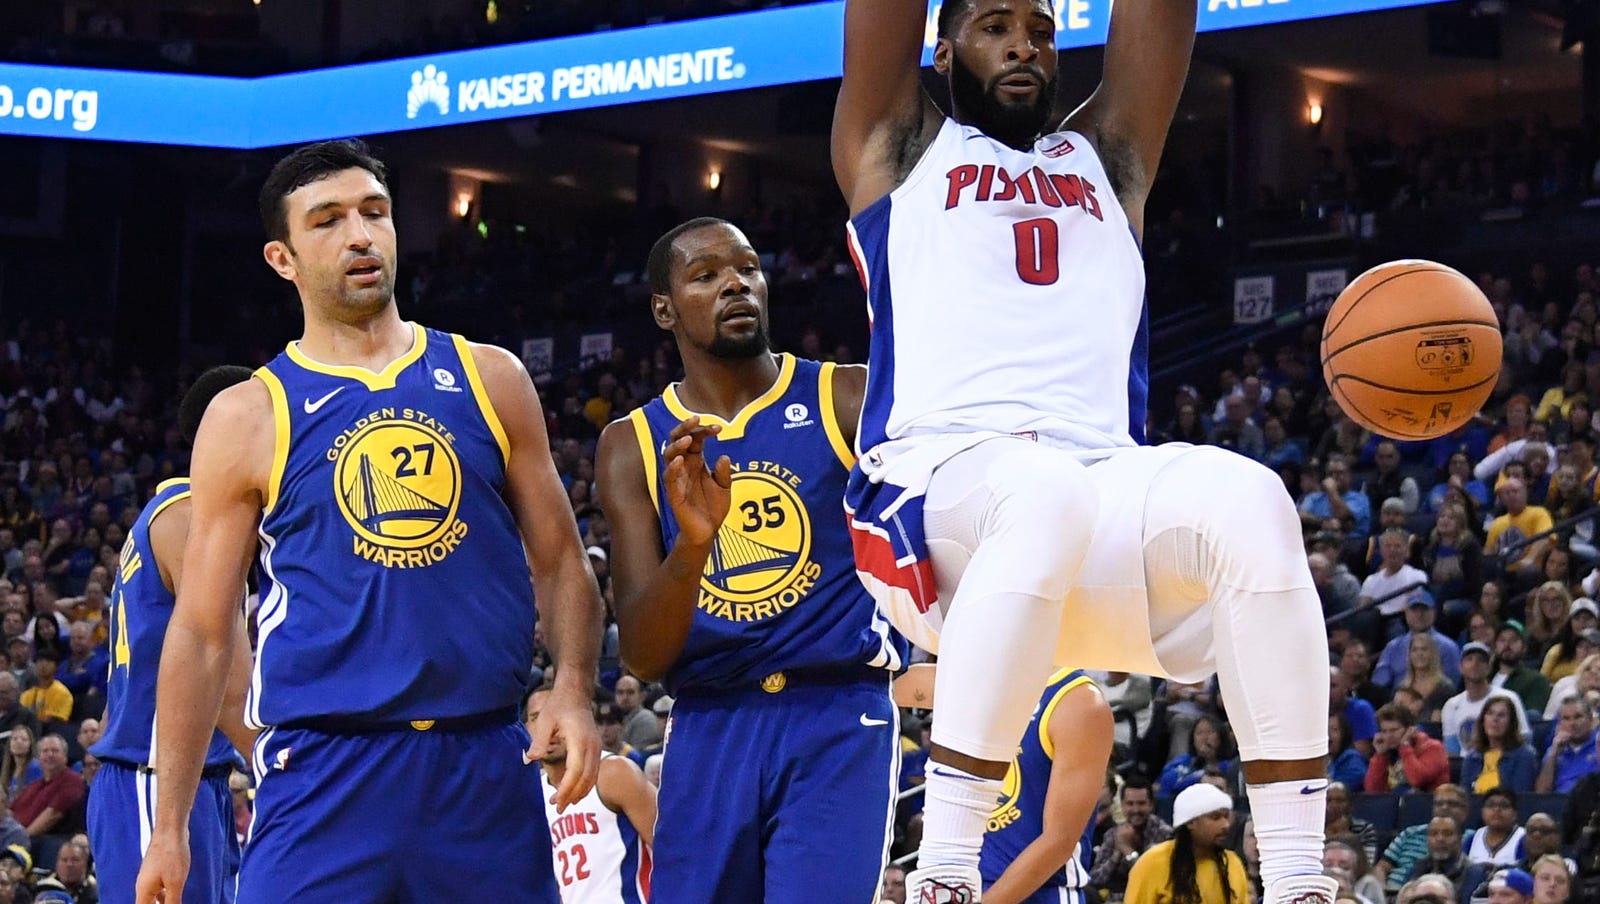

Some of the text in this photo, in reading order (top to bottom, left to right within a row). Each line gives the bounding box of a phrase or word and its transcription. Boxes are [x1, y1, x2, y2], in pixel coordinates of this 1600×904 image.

[457, 71, 545, 112] KAISER
[944, 164, 1104, 222] PISTONS
[1012, 217, 1060, 286] 0
[1239, 297, 1270, 318] 127
[326, 407, 456, 462] GOLDEN STATE
[390, 441, 435, 479] 27
[748, 460, 802, 489] STATE
[738, 495, 786, 533] 35
[352, 518, 468, 569] WARRIORS
[697, 560, 822, 622] WARRIORS
[558, 843, 591, 887] 22
